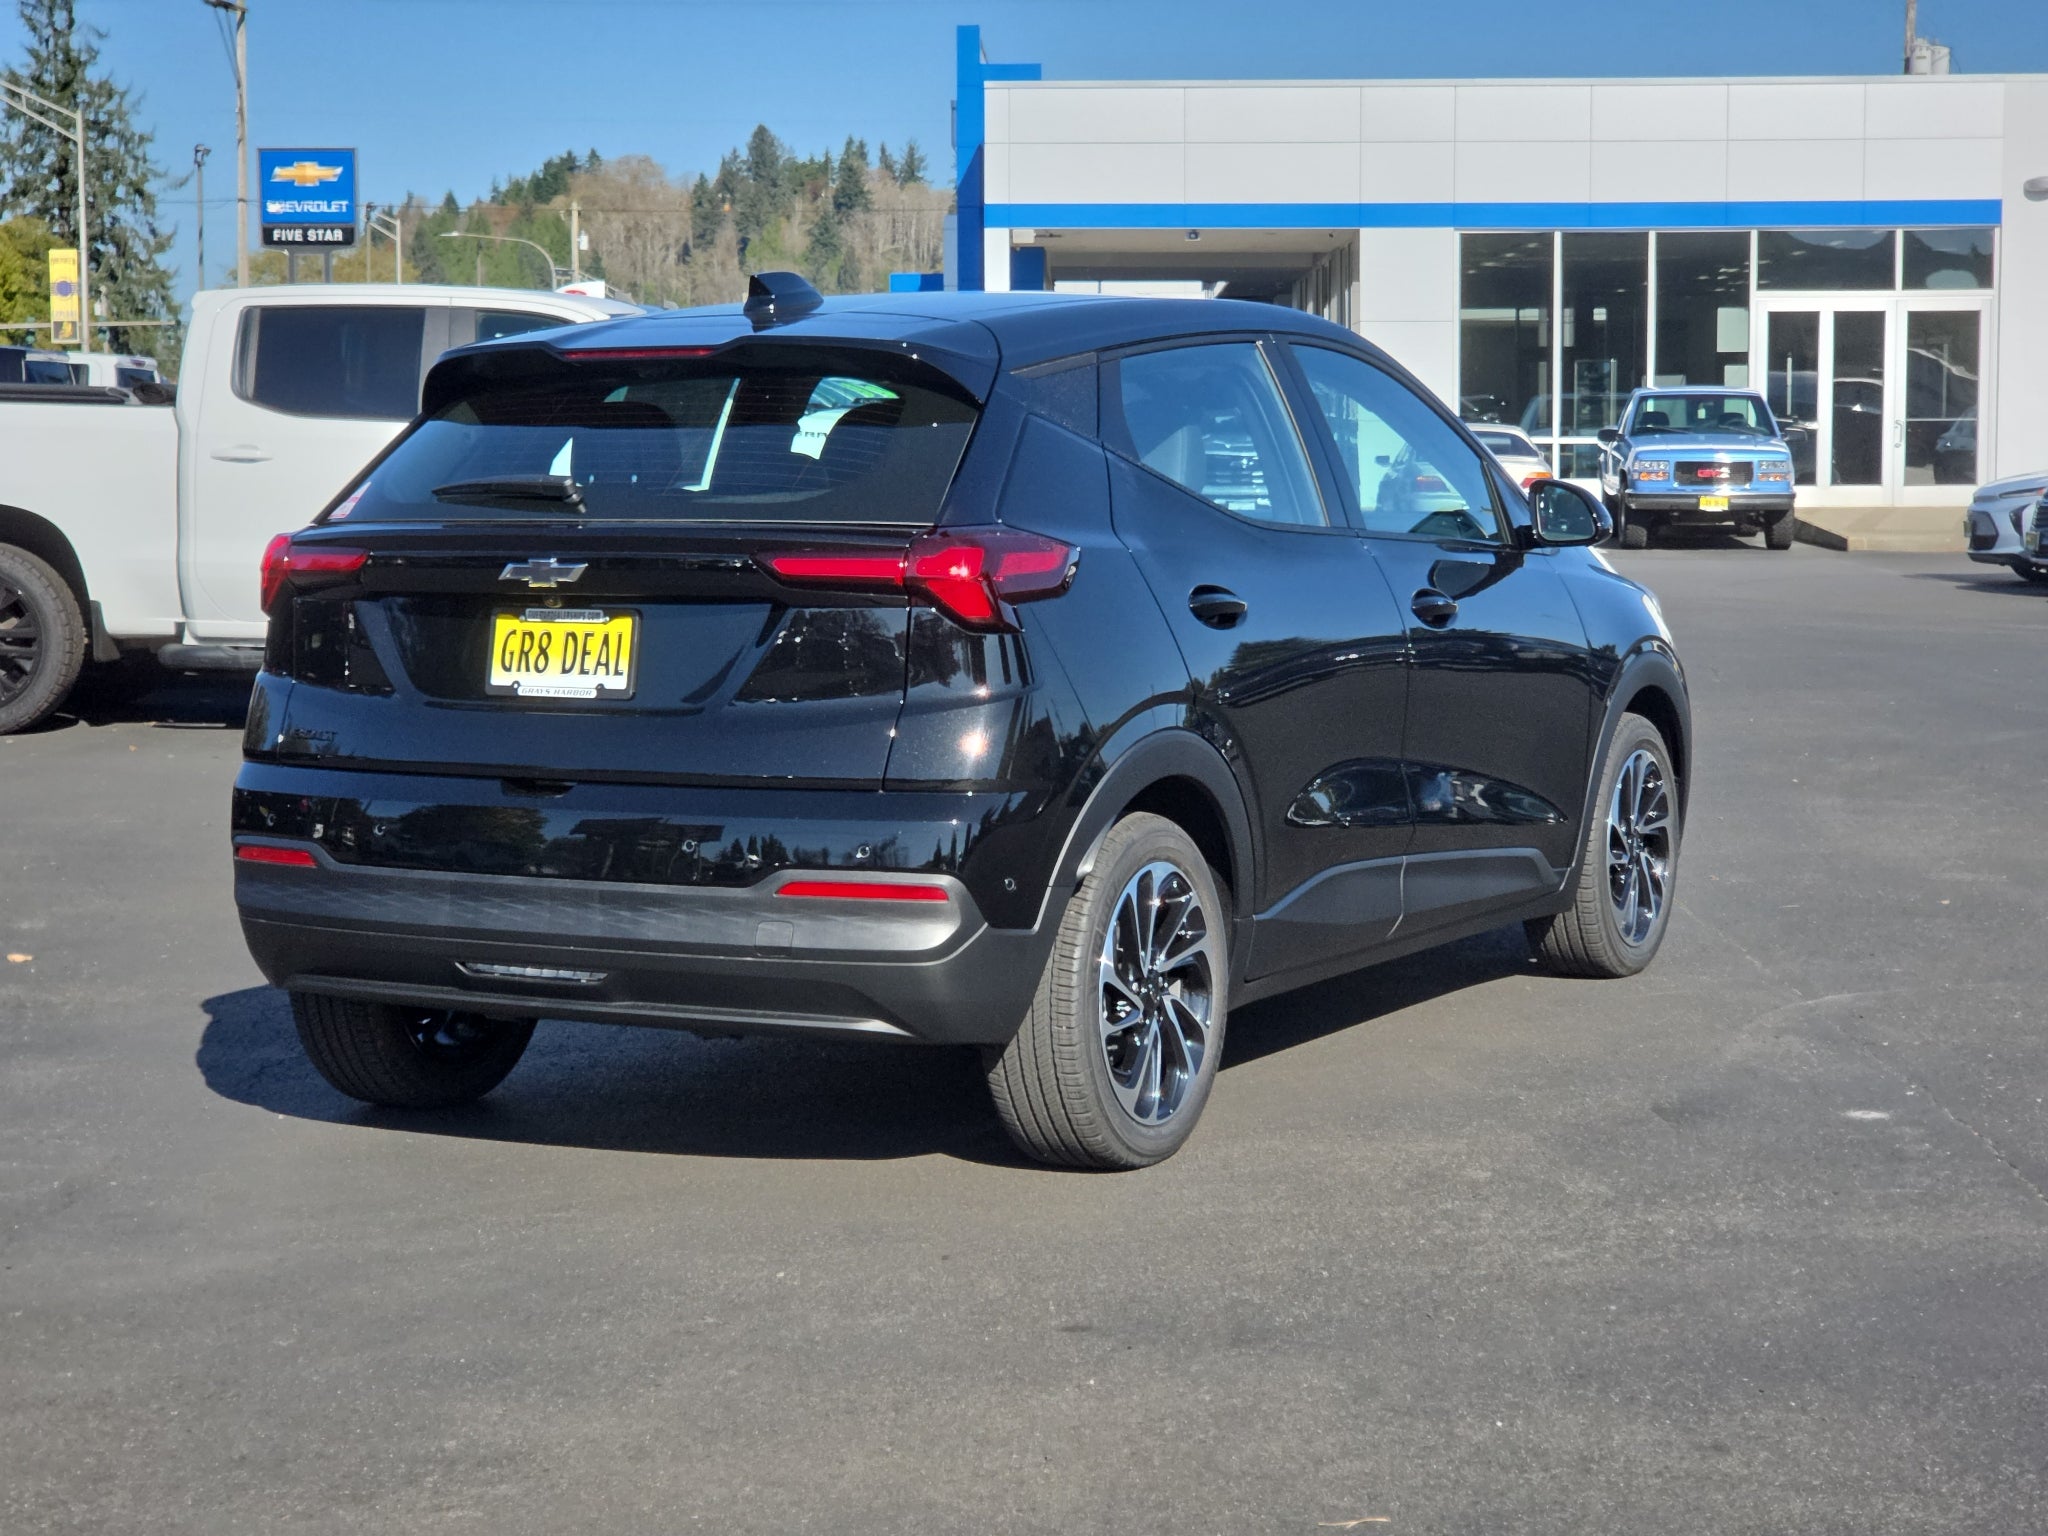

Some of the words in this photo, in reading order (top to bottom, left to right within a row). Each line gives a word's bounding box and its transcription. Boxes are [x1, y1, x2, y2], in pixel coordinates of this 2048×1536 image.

[266, 200, 348, 213] EVROLET
[273, 228, 303, 241] FIVE
[307, 228, 342, 241] STAR
[501, 629, 552, 674] GR8
[560, 630, 623, 676] DEAL
[521, 687, 551, 696] GRAYS
[553, 688, 593, 698] HARBOR
